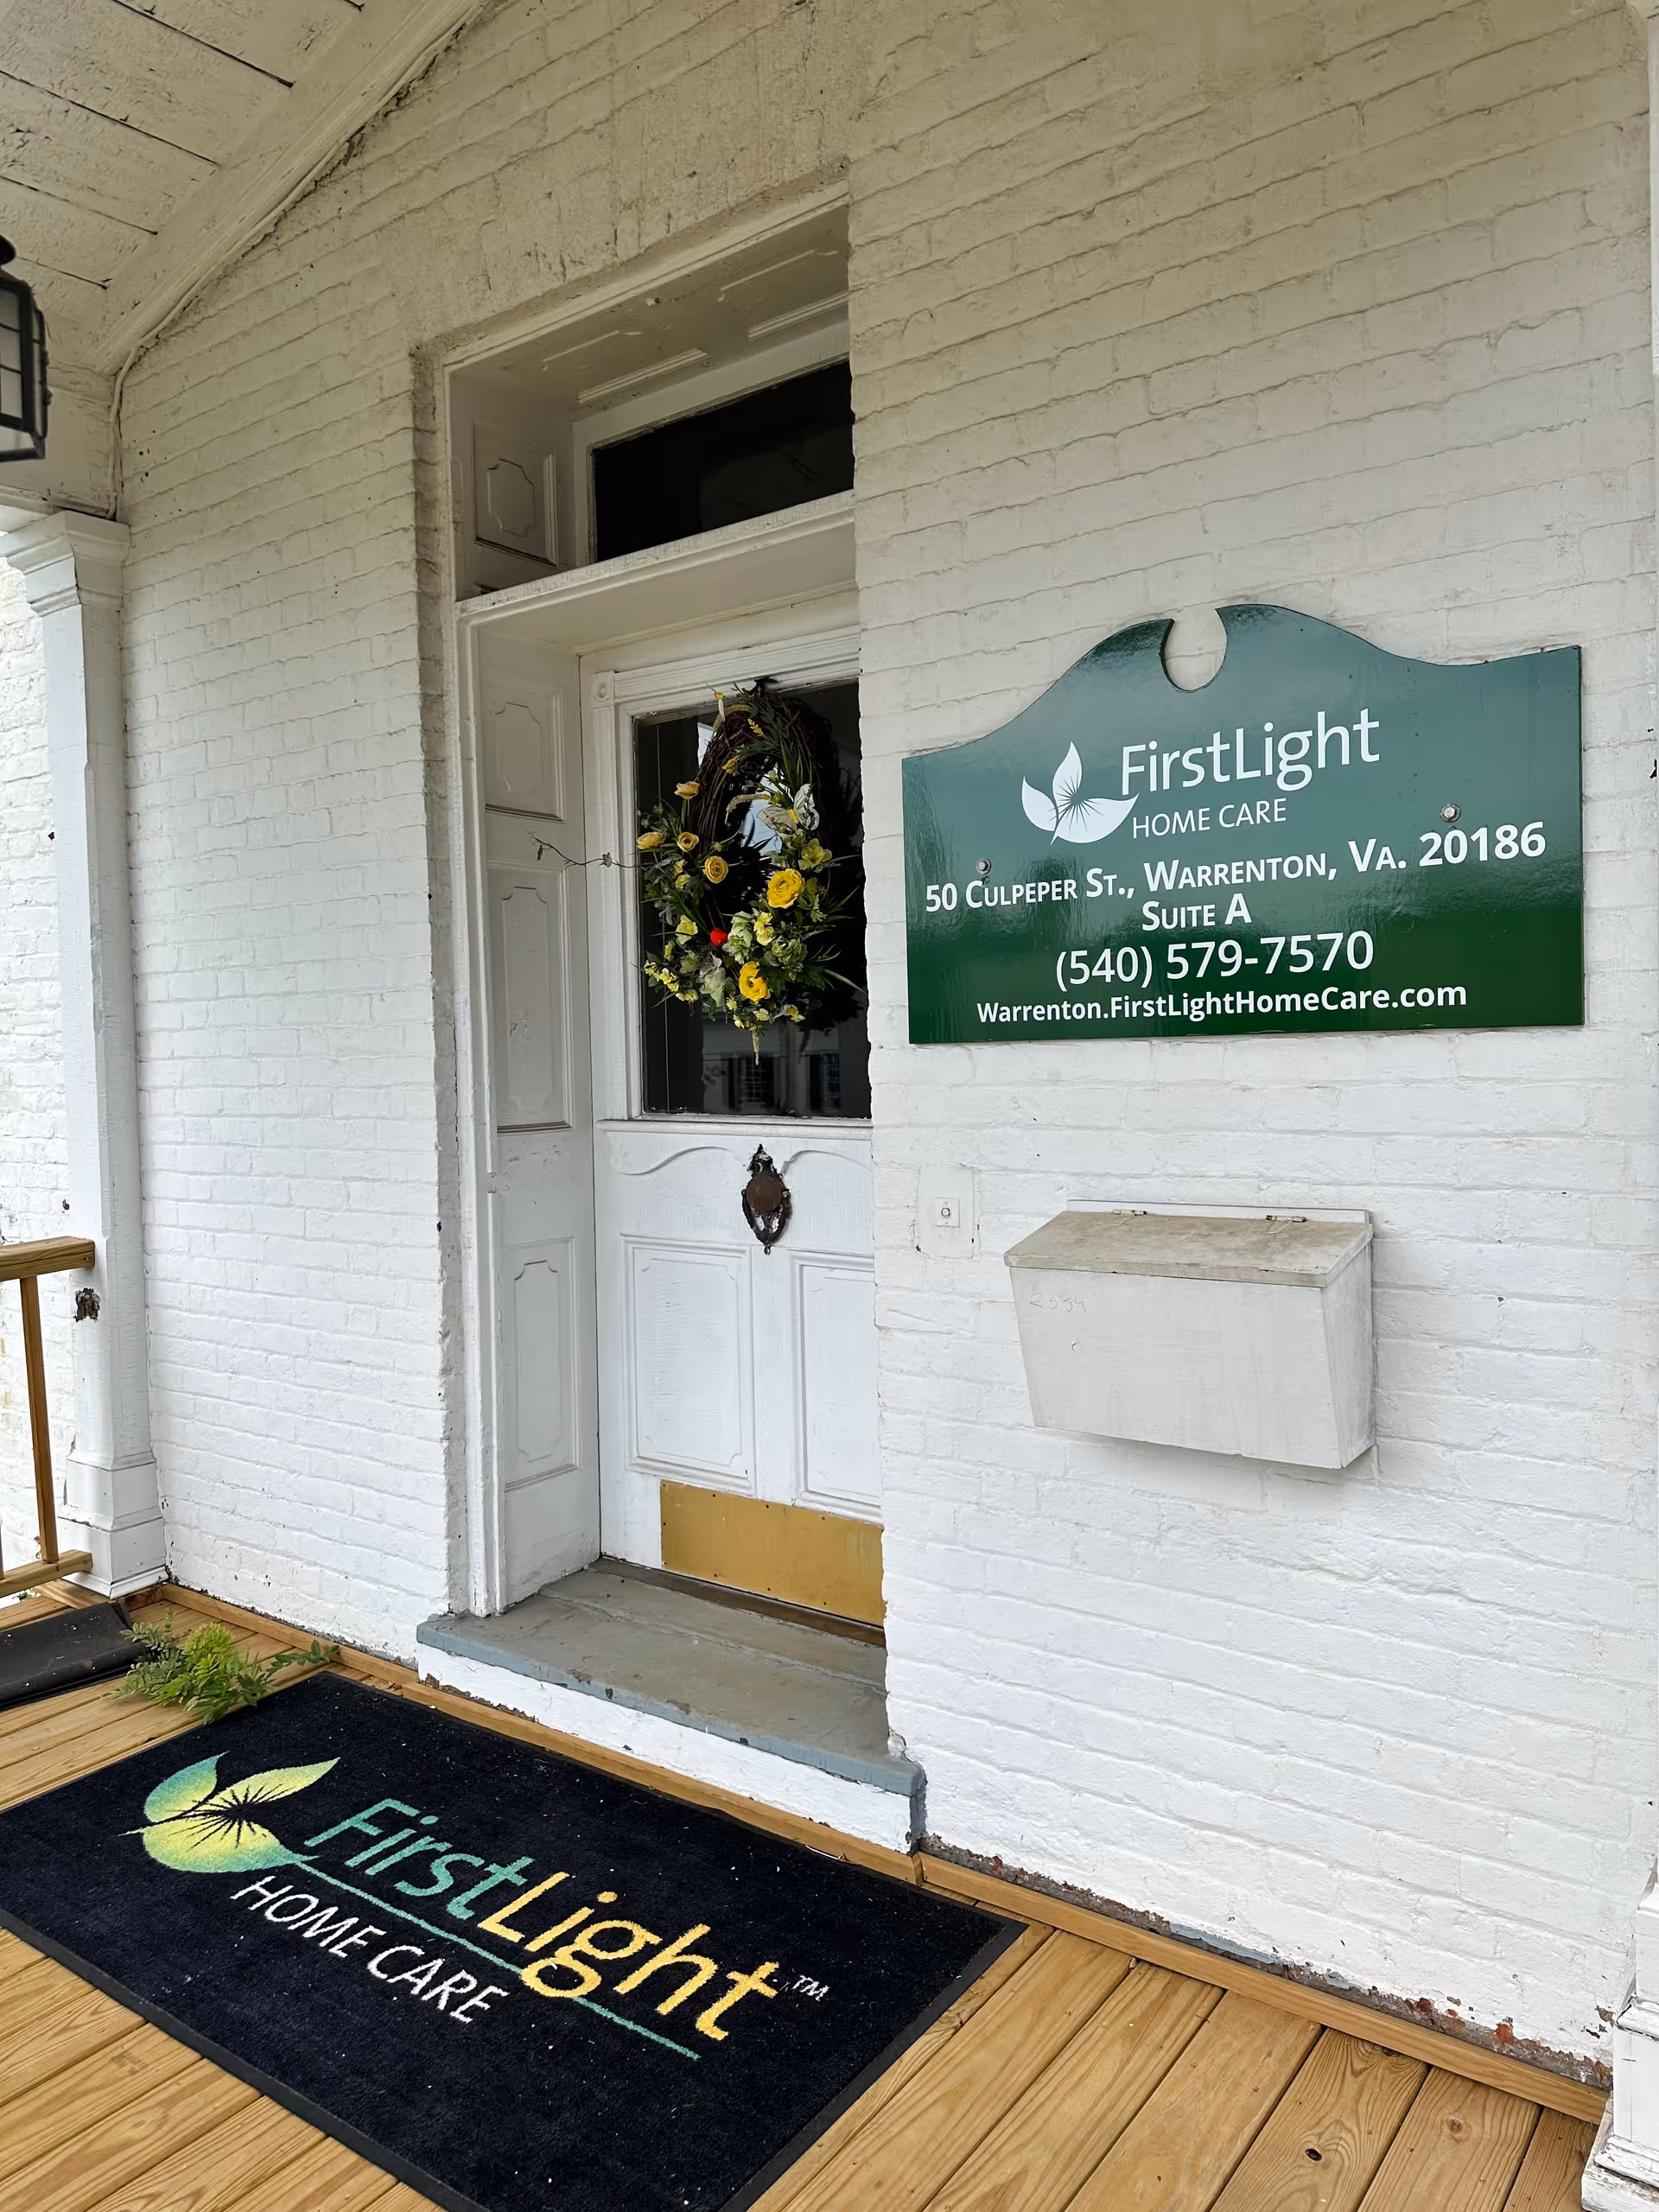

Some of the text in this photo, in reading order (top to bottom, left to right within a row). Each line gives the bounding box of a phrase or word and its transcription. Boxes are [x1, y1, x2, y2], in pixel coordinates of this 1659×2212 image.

[1122, 708, 1380, 796] FirstLight
[1133, 798, 1287, 839] HOME CARE
[925, 882, 957, 912] 50
[965, 873, 1078, 909] CULPEPER
[1419, 821, 1547, 868] 20186
[1142, 893, 1252, 932] SUITE A
[1056, 931, 1375, 992] (540) 579-7570
[976, 986, 1467, 1024] Warrenton.FirstLightHomeCare.com
[230, 1875, 511, 2024] HOME CARE
[303, 1797, 779, 2042] FirstLight
